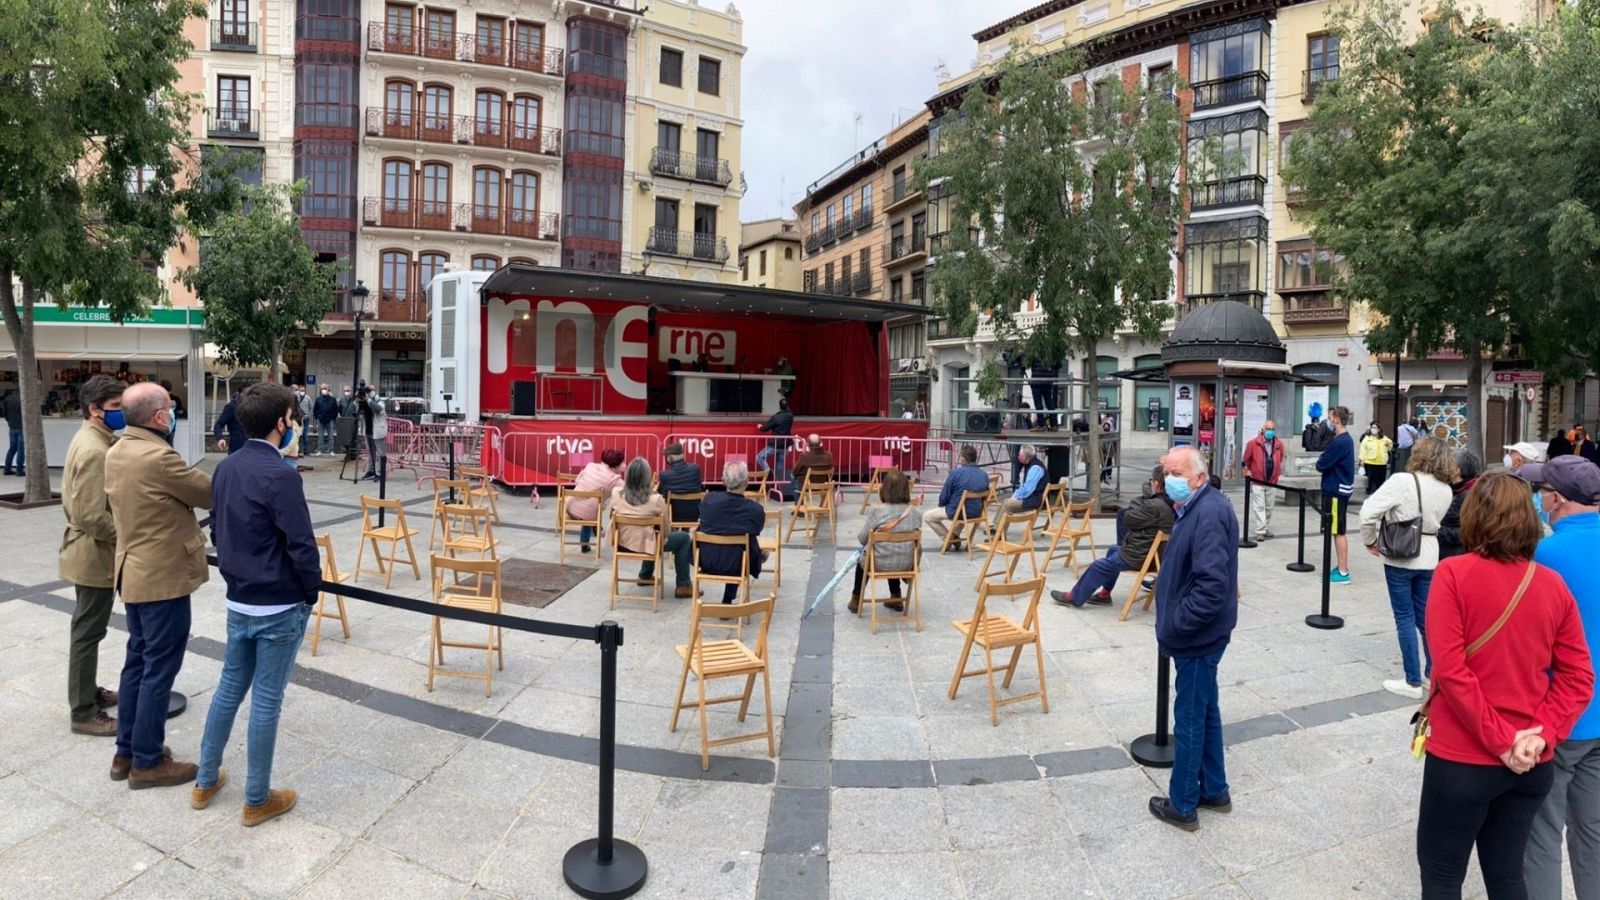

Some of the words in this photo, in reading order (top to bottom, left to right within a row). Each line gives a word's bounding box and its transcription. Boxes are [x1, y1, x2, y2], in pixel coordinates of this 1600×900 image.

[73, 312, 111, 321] CELEBRE
[487, 297, 648, 400] rne
[669, 329, 725, 363] rne
[546, 435, 593, 455] rtve
[678, 437, 715, 458] rne
[884, 435, 911, 453] rne
